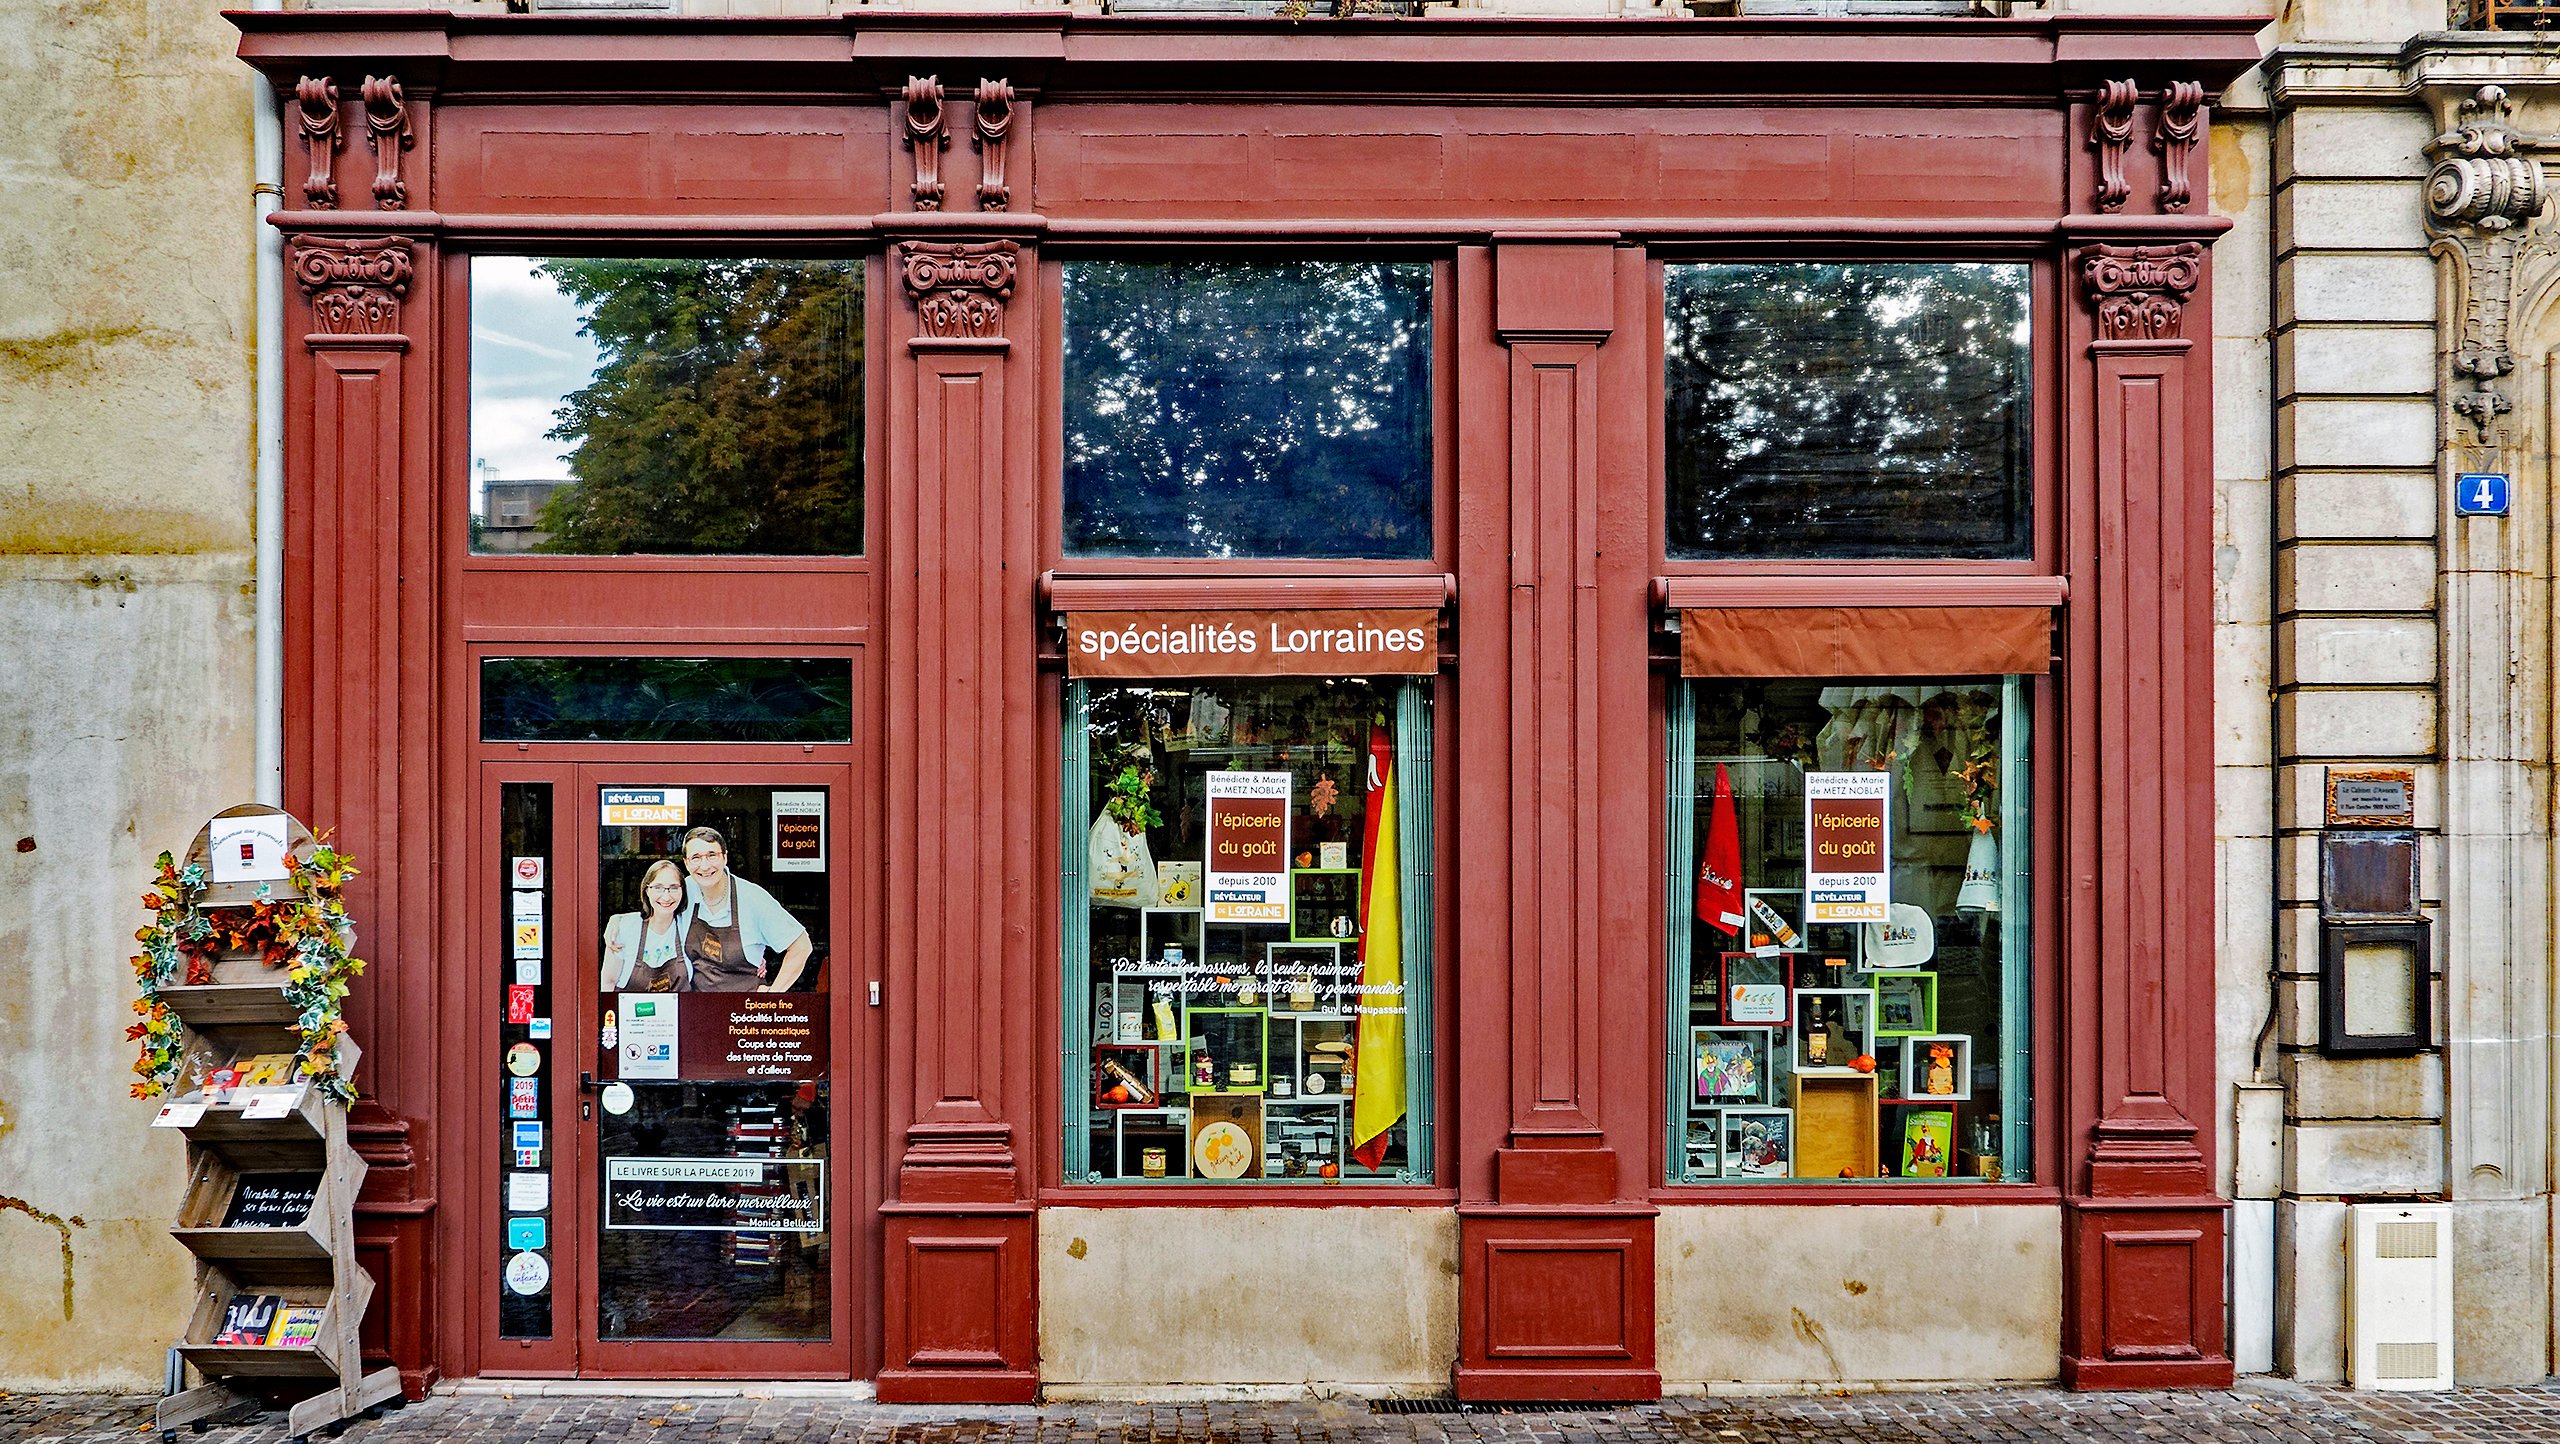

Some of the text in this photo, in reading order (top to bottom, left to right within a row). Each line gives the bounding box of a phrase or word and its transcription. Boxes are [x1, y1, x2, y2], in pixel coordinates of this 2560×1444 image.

[2472, 479, 2493, 509] 4
[1080, 623, 1425, 661] spécialités Lorraines
[1211, 775, 1250, 783] Bénédicte
[1262, 776, 1287, 784] Marie
[1810, 776, 1884, 784] Bénédicte & Marie
[1211, 786, 1221, 794] de
[1224, 786, 1248, 794] METZ
[1810, 786, 1884, 795] de METZ NOBLAT
[608, 794, 660, 804] RÉVÉLATEUR
[1215, 812, 1281, 830] l'épicerie
[1814, 813, 1880, 831] l'épicerie
[779, 823, 818, 834] l'épicerie
[782, 838, 816, 850] du goût
[1218, 840, 1277, 858] du goût
[1818, 840, 1876, 858] du goût
[1218, 876, 1277, 887] depuis 2010
[1819, 876, 1877, 888] depuis 2010
[1214, 892, 1262, 902] RÉVÉLATEUR
[1814, 892, 1862, 902] RÉVÉLATEUR
[1137, 958, 1174, 973] toutes
[1175, 958, 1195, 974] les
[1194, 960, 1251, 977] passions,
[1254, 959, 1272, 975] la
[1272, 961, 1307, 975] seule
[1306, 961, 1366, 976] vraiment
[1148, 976, 1220, 994] respectable
[1219, 982, 1240, 993] me
[1307, 978, 1327, 995] la
[745, 998, 793, 1010] Épicerie fine
[1321, 1004, 1408, 1016] Guy de Maupassant
[729, 1012, 809, 1024] Spécialités lorraines
[728, 1025, 810, 1037] Produits monastiques
[737, 1038, 764, 1050] Coups
[765, 1038, 778, 1048] de
[726, 1051, 813, 1062] des terroirs de France
[746, 1065, 756, 1075] et
[514, 1080, 533, 1090] 2019
[512, 1093, 536, 1105] petit
[617, 1167, 755, 1178] LE LIVRE SUR LA PLACE 2019
[646, 1194, 667, 1207] vie
[666, 1193, 690, 1208] est
[686, 1196, 706, 1208] un
[705, 1193, 737, 1208] livre
[749, 1217, 819, 1228] Monica Bellucci
